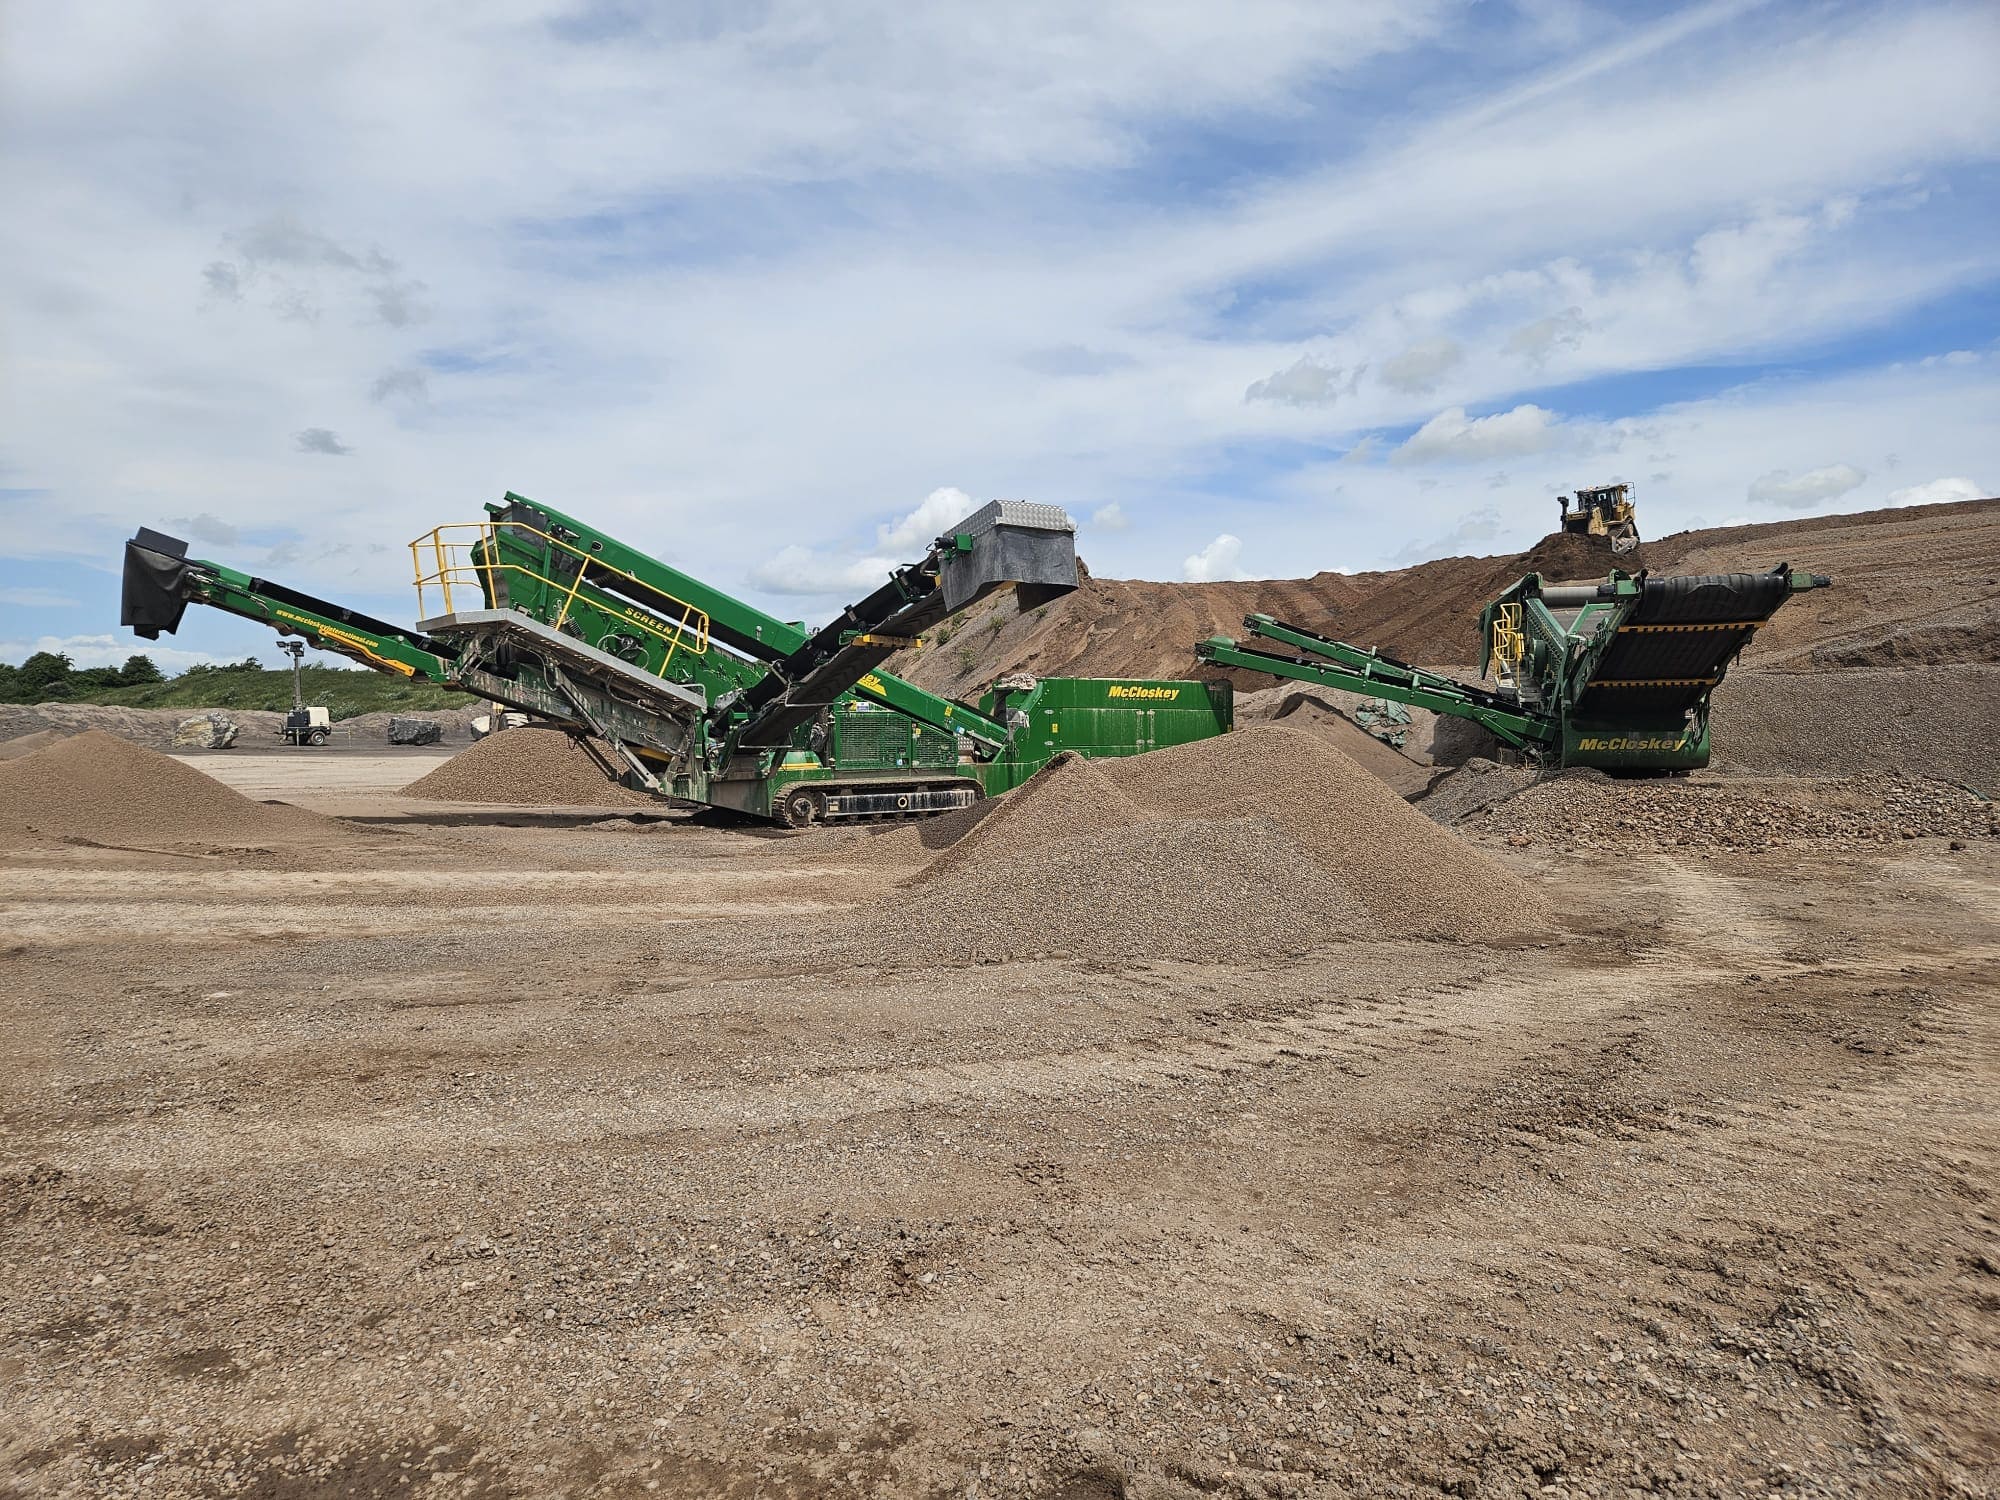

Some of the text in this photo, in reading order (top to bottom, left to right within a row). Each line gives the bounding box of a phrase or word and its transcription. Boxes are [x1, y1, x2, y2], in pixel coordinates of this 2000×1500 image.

[625, 607, 673, 634] SCREEN
[1108, 685, 1180, 701] McCloskey
[1579, 738, 1687, 752] McCloskey
